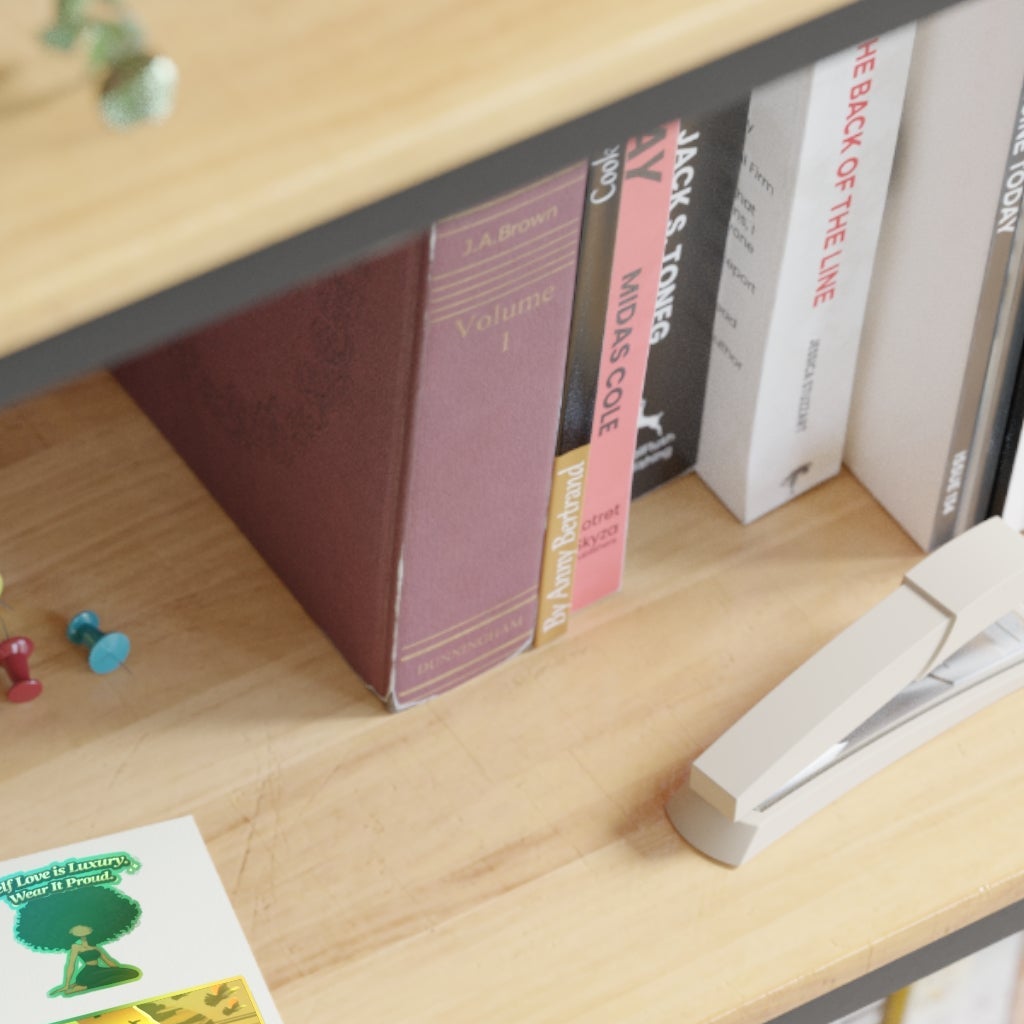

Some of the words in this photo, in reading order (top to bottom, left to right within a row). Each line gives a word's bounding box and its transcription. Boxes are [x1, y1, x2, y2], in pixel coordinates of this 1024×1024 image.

[840, 78, 872, 154] BACK
[668, 129, 701, 211] JACK
[834, 156, 860, 191] OF
[823, 194, 853, 250] THE
[812, 250, 843, 308] LINE
[455, 284, 556, 339] Volume
[609, 266, 642, 365] MIDAS
[598, 367, 626, 437] COLE
[551, 459, 585, 551] Bertrand
[542, 603, 572, 633] By
[9, 886, 48, 905] Wear
[51, 881, 64, 893] It
[66, 870, 114, 889] Proud.
[16, 870, 50, 888] Love
[53, 865, 66, 877] is
[68, 855, 129, 873] Luxury.
